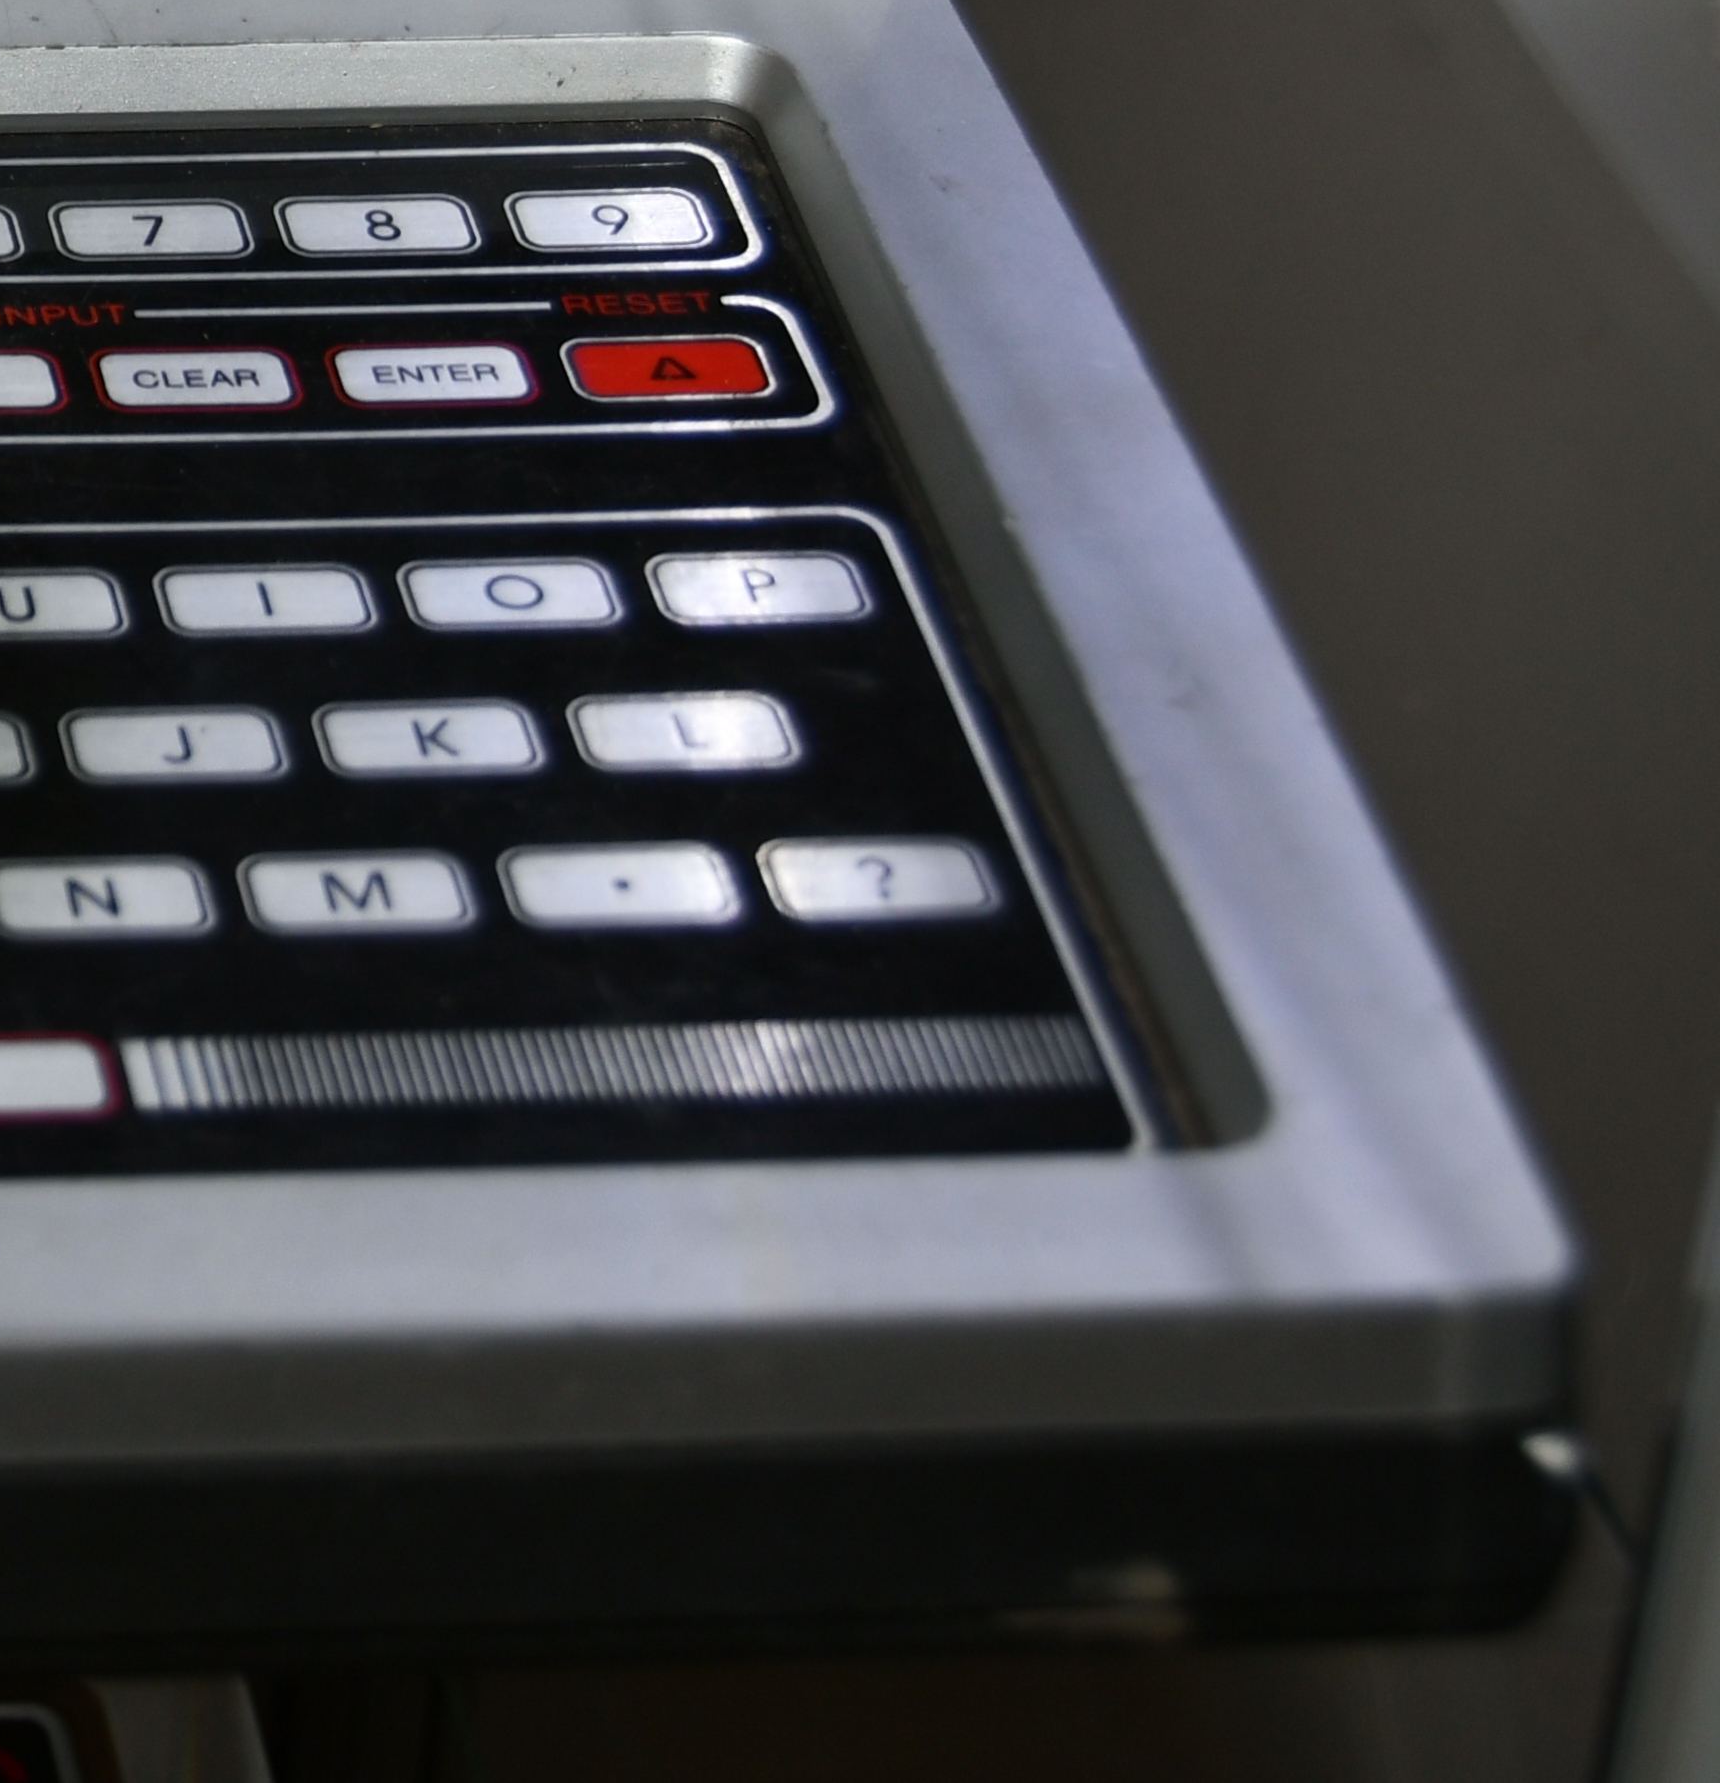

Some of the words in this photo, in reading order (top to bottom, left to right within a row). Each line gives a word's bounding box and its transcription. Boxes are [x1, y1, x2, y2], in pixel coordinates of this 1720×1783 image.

[130, 212, 166, 249] 7
[363, 207, 404, 244] 8
[589, 202, 632, 238] 9
[560, 289, 710, 317] RESET
[131, 368, 261, 390] CLEAR
[370, 362, 500, 386] ENTER
[255, 579, 276, 619] I
[740, 564, 781, 605] P
[163, 723, 196, 766] J
[410, 716, 460, 759] K
[668, 709, 702, 752] L
[62, 875, 123, 920] N
[320, 867, 394, 914] M
[856, 854, 894, 901] ?
